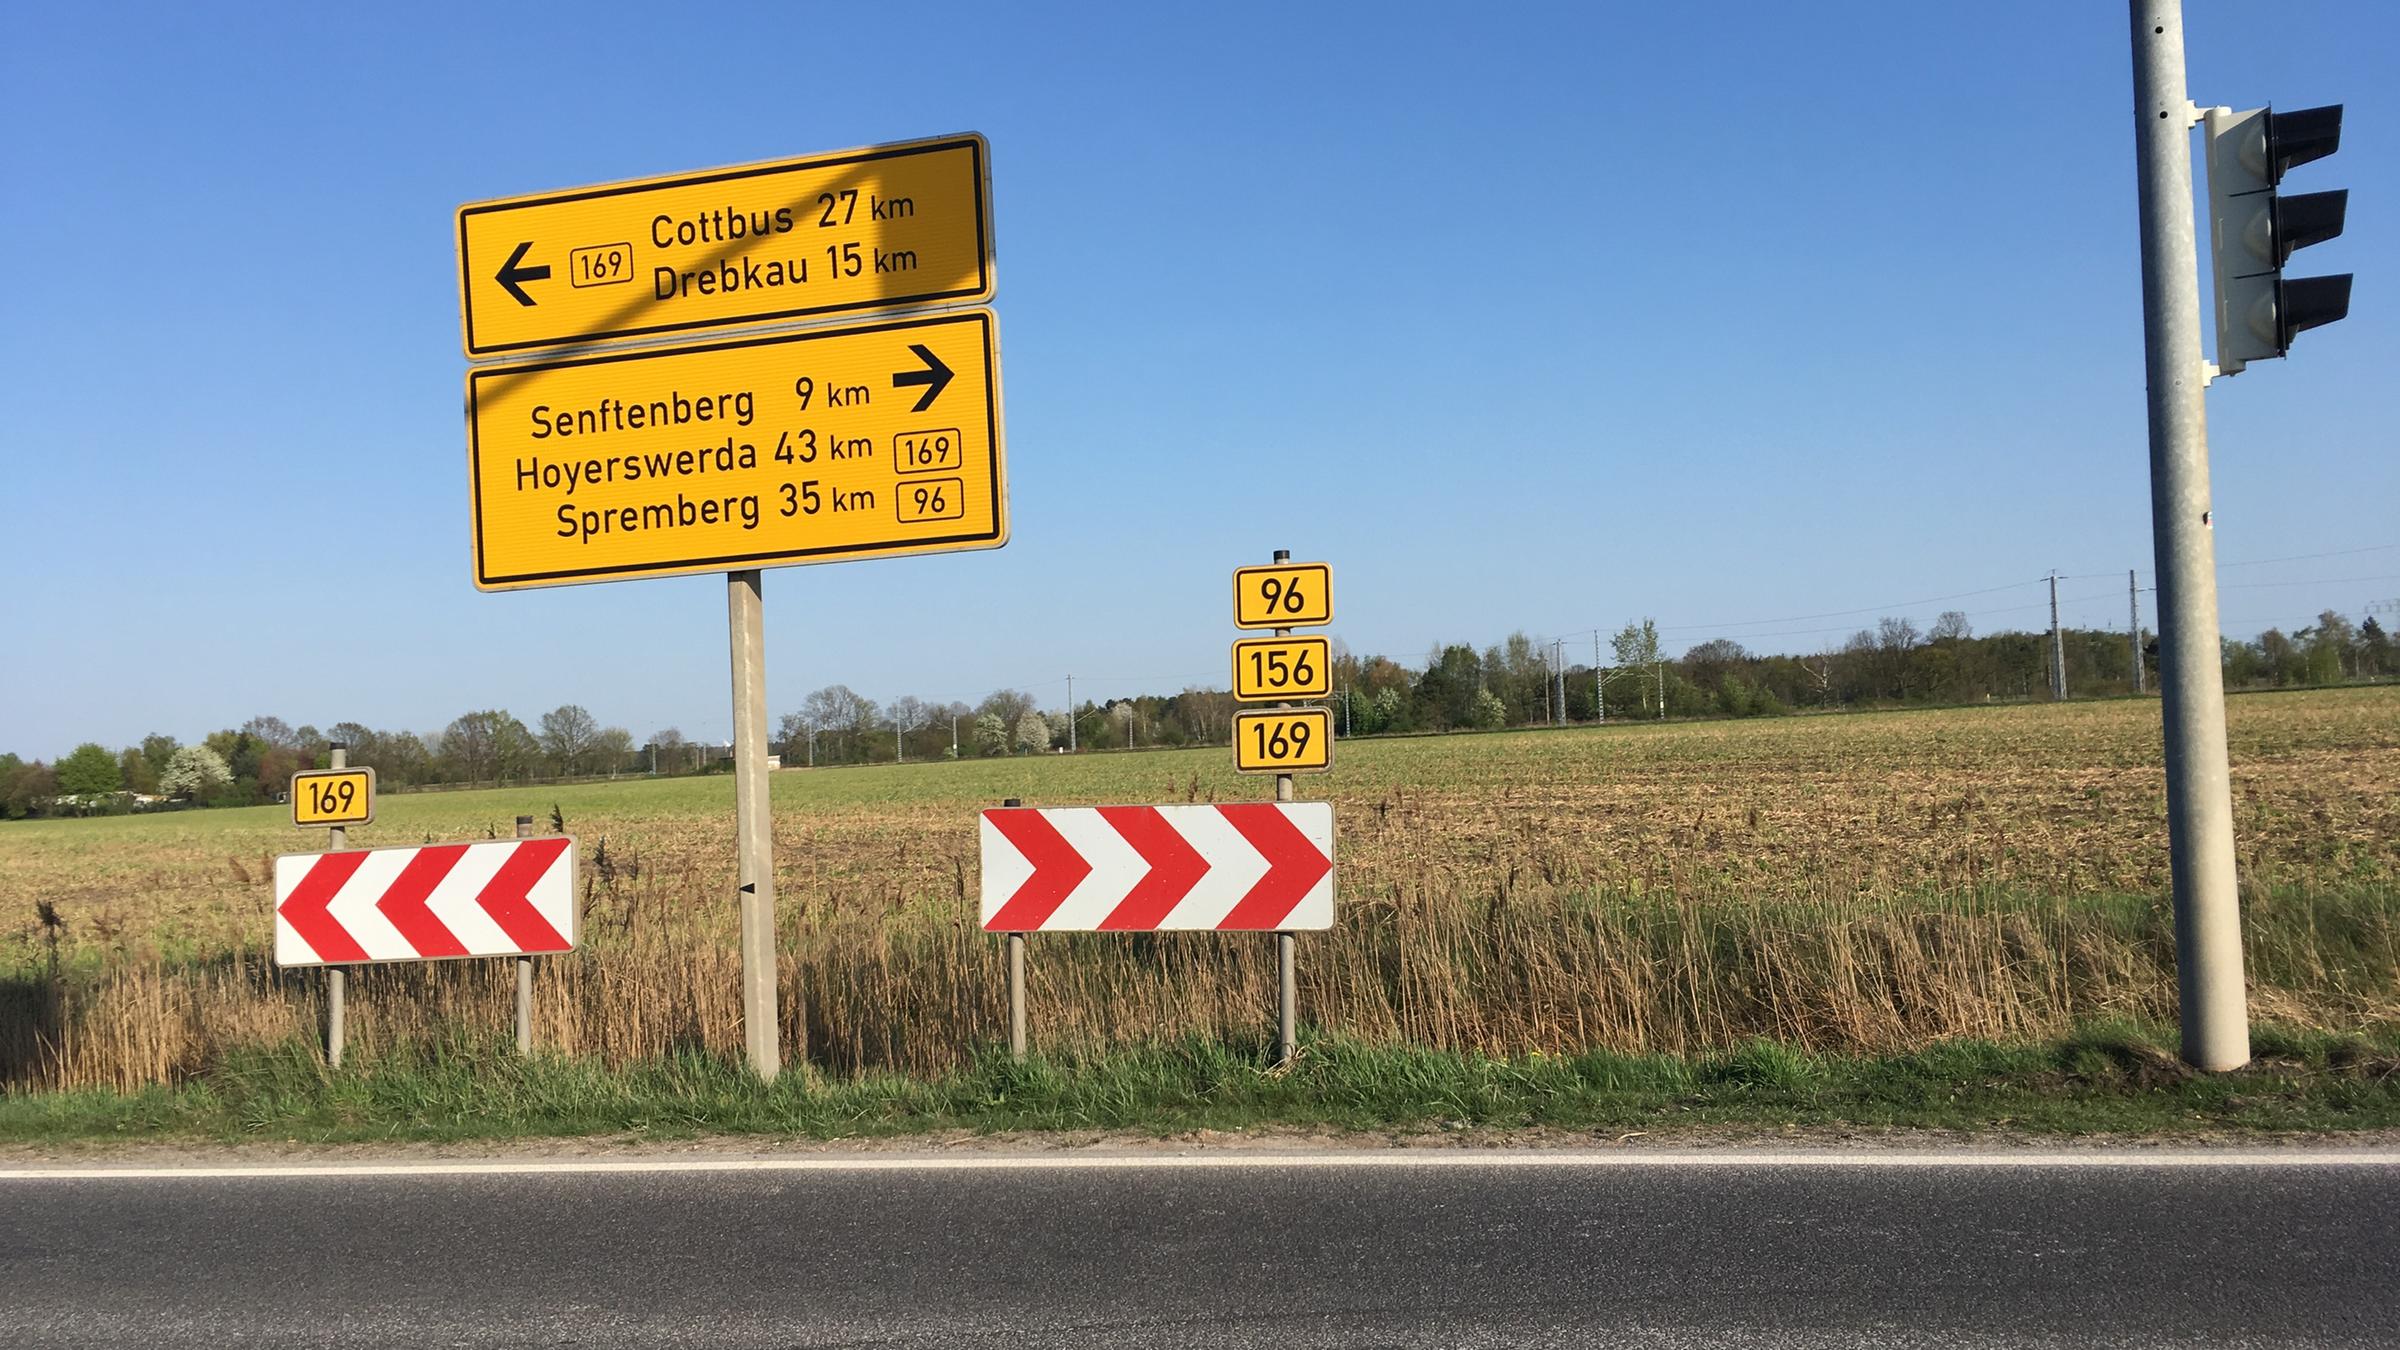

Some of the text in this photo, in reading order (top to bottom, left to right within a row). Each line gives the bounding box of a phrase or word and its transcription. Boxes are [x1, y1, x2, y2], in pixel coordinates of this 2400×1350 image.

[651, 189, 915, 250] Cottbus 27 km
[580, 250, 622, 280] 169
[654, 242, 917, 301] Drebkau 15 km
[531, 377, 870, 439] Senftenberg 9 km
[516, 428, 873, 495] Hoyerswerda 43 km
[904, 437, 949, 466] 169
[556, 481, 875, 544] Spremberg 35 km
[913, 486, 946, 515] 96
[1261, 577, 1304, 614] 96
[1251, 649, 1314, 688] 156
[1253, 721, 1310, 759] 169
[309, 780, 355, 815] 169
